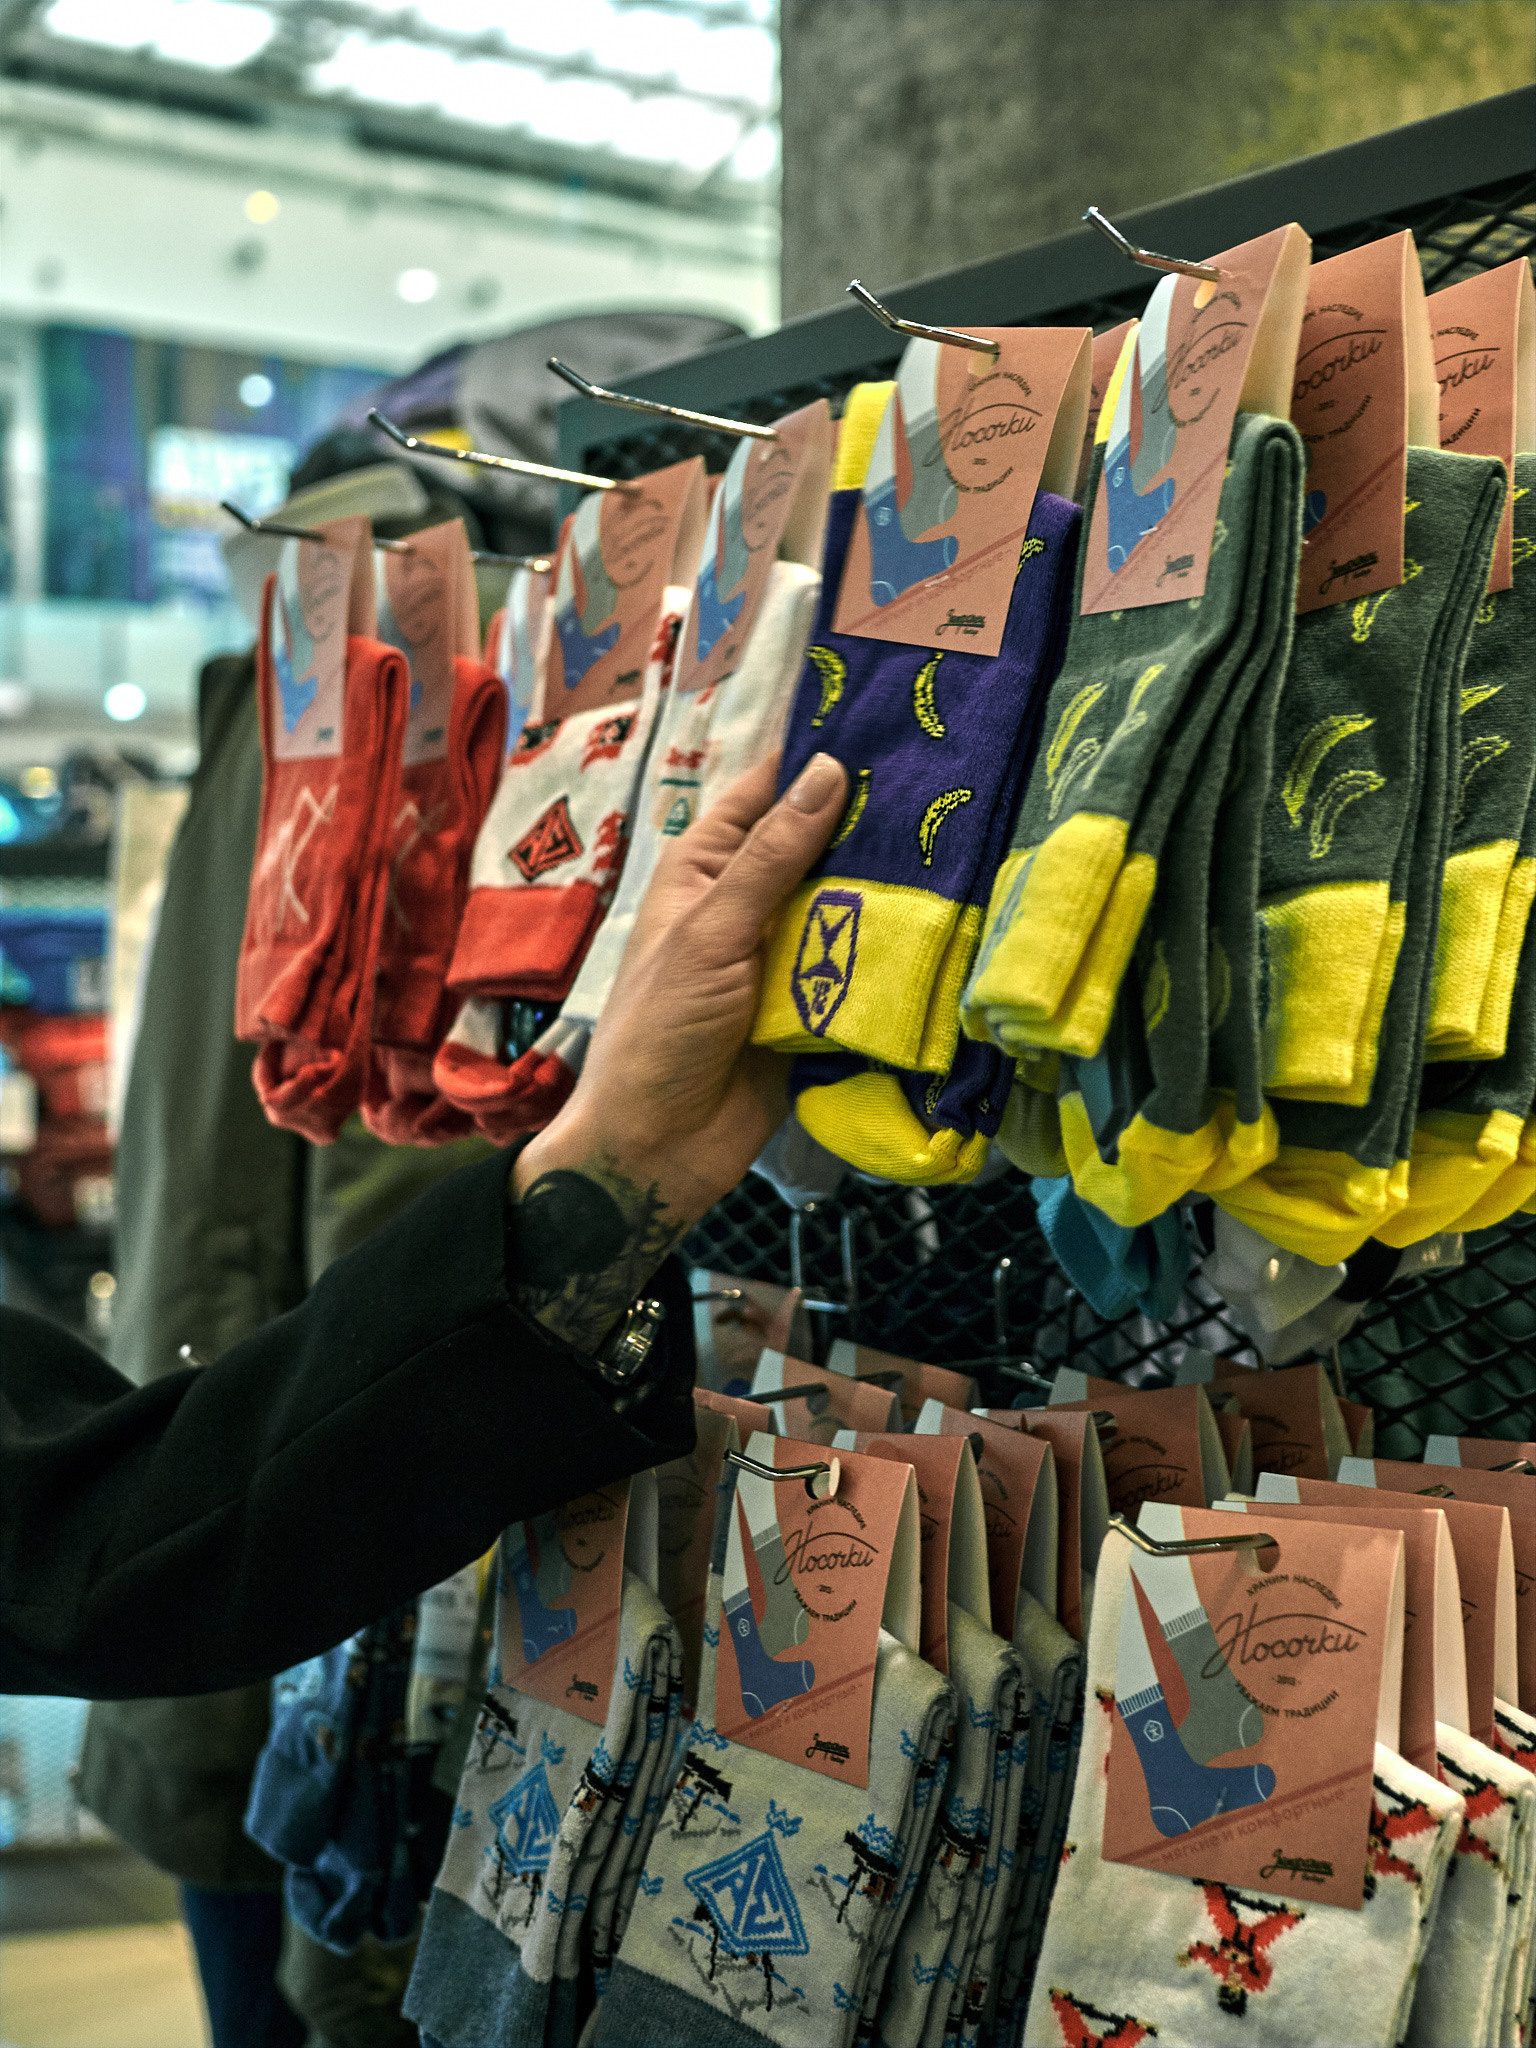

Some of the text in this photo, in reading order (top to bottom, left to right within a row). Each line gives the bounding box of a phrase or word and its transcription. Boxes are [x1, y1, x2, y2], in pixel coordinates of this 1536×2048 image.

[1291, 329, 1387, 404] осочки
[922, 397, 1043, 467] Носочки
[773, 1520, 879, 1585] Носочки
[1246, 1574, 1289, 1597] ХРАНИМ
[1200, 1602, 1367, 1680] Носочки
[1284, 1689, 1340, 1719] ТРАДИЦИИ
